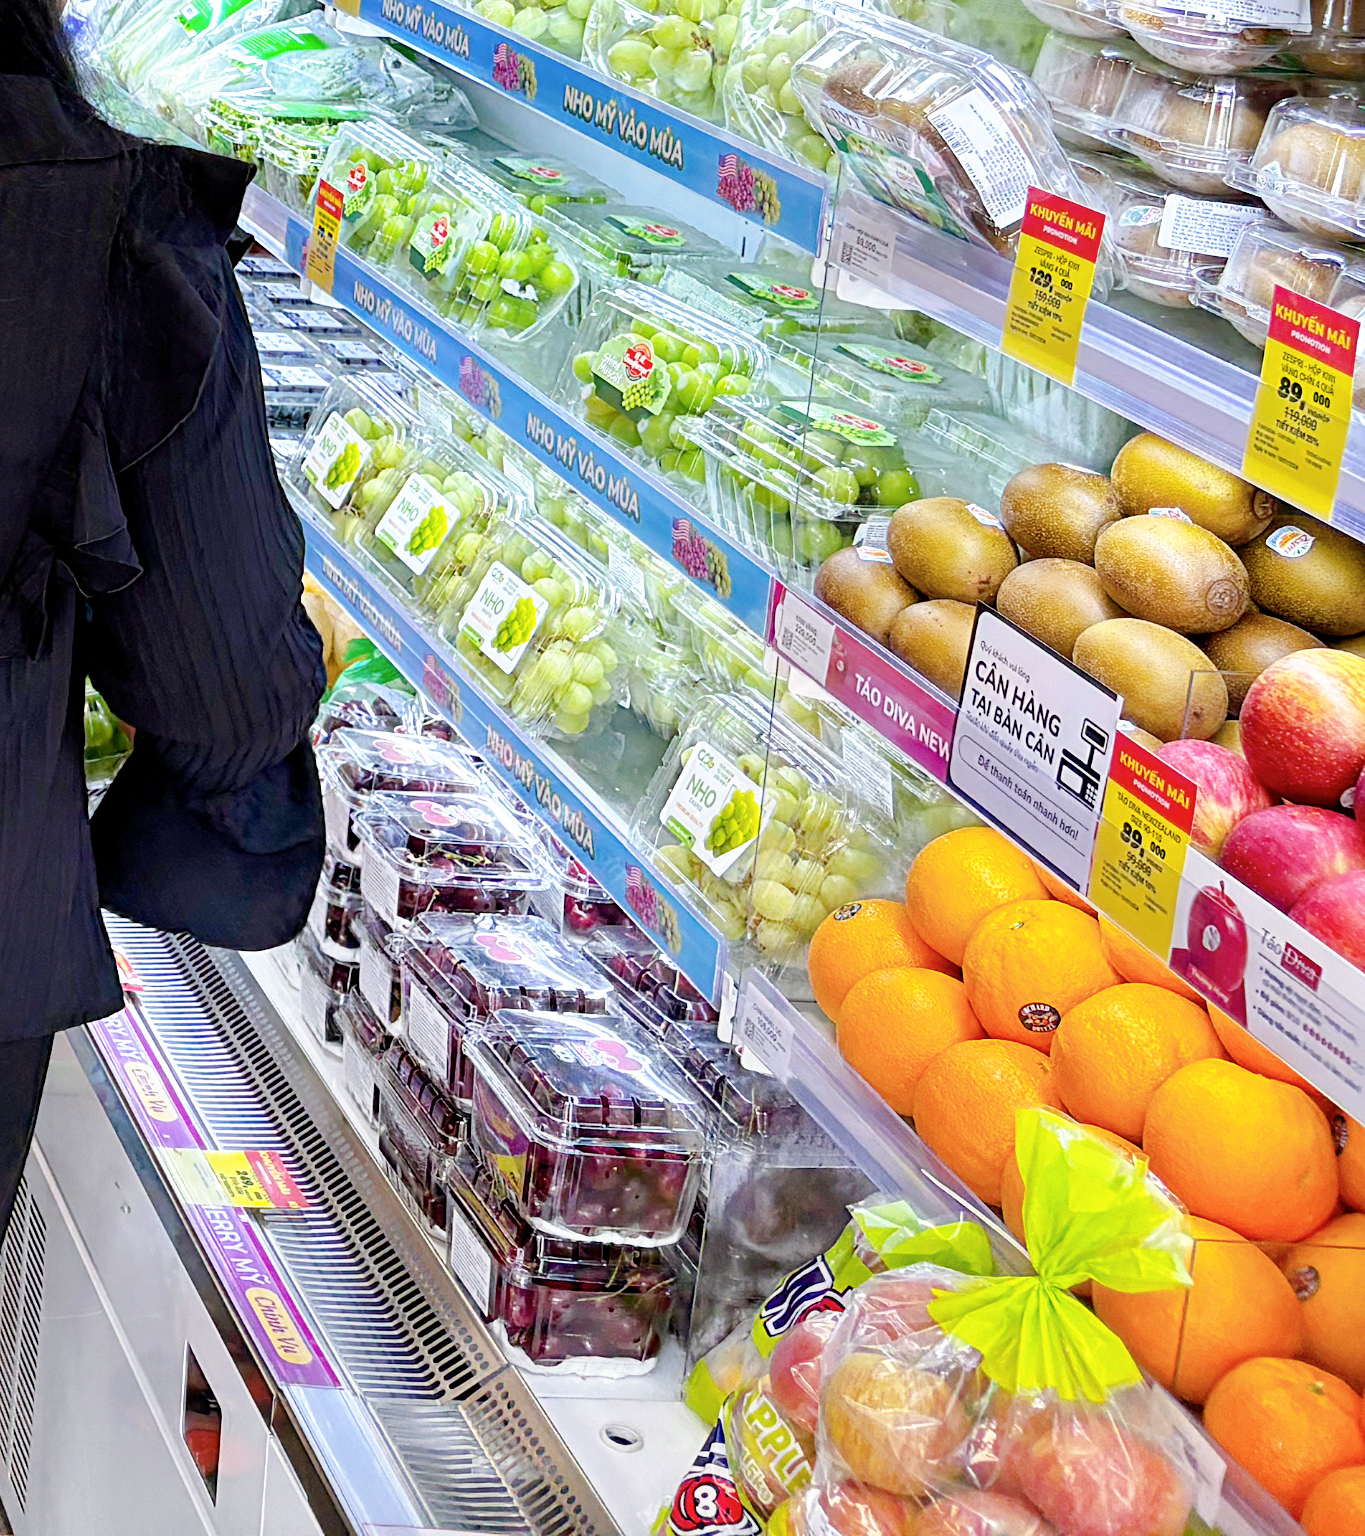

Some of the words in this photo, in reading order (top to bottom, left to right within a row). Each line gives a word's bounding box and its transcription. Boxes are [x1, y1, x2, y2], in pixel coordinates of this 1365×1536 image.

[406, 5, 423, 31] MỸ
[421, 12, 444, 44] VÀO
[445, 26, 470, 58] MÙA
[563, 84, 594, 119] NHO
[594, 97, 617, 136] MỸ
[616, 114, 648, 150] VÀO
[649, 125, 683, 171] MÙA
[1030, 203, 1074, 231] KHUYẾN
[1076, 221, 1097, 239] MÃI
[1043, 225, 1078, 245] PROMOTION
[352, 282, 377, 315] NHO
[375, 294, 394, 329] MỸ
[392, 306, 415, 344] VÀO
[413, 322, 437, 362] MÙA
[1275, 303, 1325, 338] KHUYẾN
[1327, 325, 1351, 350] MÃI
[1291, 330, 1331, 354] PROMOTION
[525, 411, 555, 453] NHO
[554, 431, 579, 471] MỸ
[577, 450, 606, 494] VÀO
[606, 472, 640, 522] MÙA
[397, 497, 419, 521] NHO
[480, 589, 505, 615] NHO
[976, 660, 1009, 699] CÂN
[1012, 686, 1061, 737] HÀNG
[971, 687, 991, 717] TẠI
[994, 703, 1023, 740] BÀN
[1026, 731, 1055, 765] CÂN
[686, 774, 716, 808] NHO
[978, 754, 989, 771] Để
[991, 762, 1012, 789] thanh
[1014, 782, 1031, 804] toán
[1033, 795, 1058, 826] nhanh
[1059, 818, 1079, 840] hơn!
[1120, 750, 1165, 792] KHUYẾN
[1167, 783, 1190, 810] MÃI
[1261, 928, 1282, 955] Táo
[1284, 949, 1317, 981] Diva
[255, 1294, 281, 1338] Chính
